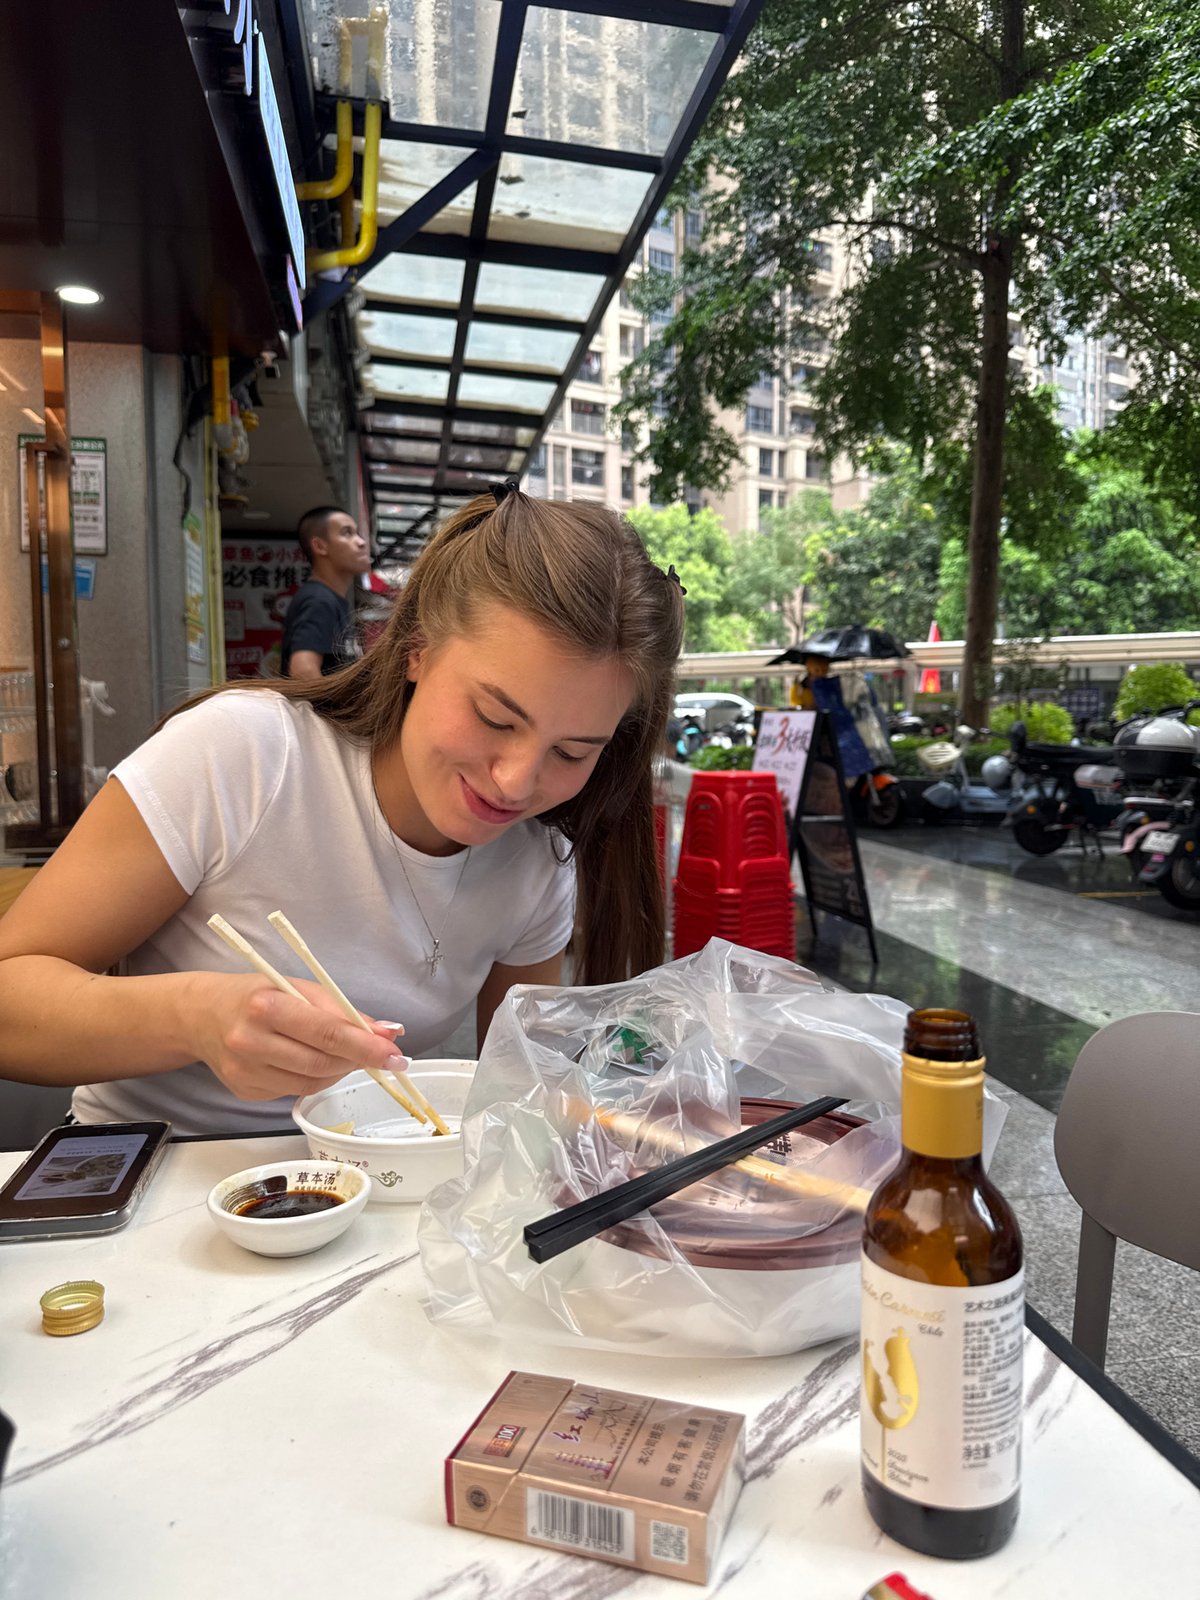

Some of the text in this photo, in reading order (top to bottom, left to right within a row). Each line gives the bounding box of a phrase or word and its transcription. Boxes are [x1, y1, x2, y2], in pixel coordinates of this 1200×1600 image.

[296, 1171, 336, 1185] 草本汤
[499, 1424, 518, 1440] 100
[637, 1422, 666, 1466] 本公司提示
[660, 1417, 702, 1489] 吸烟有害健康
